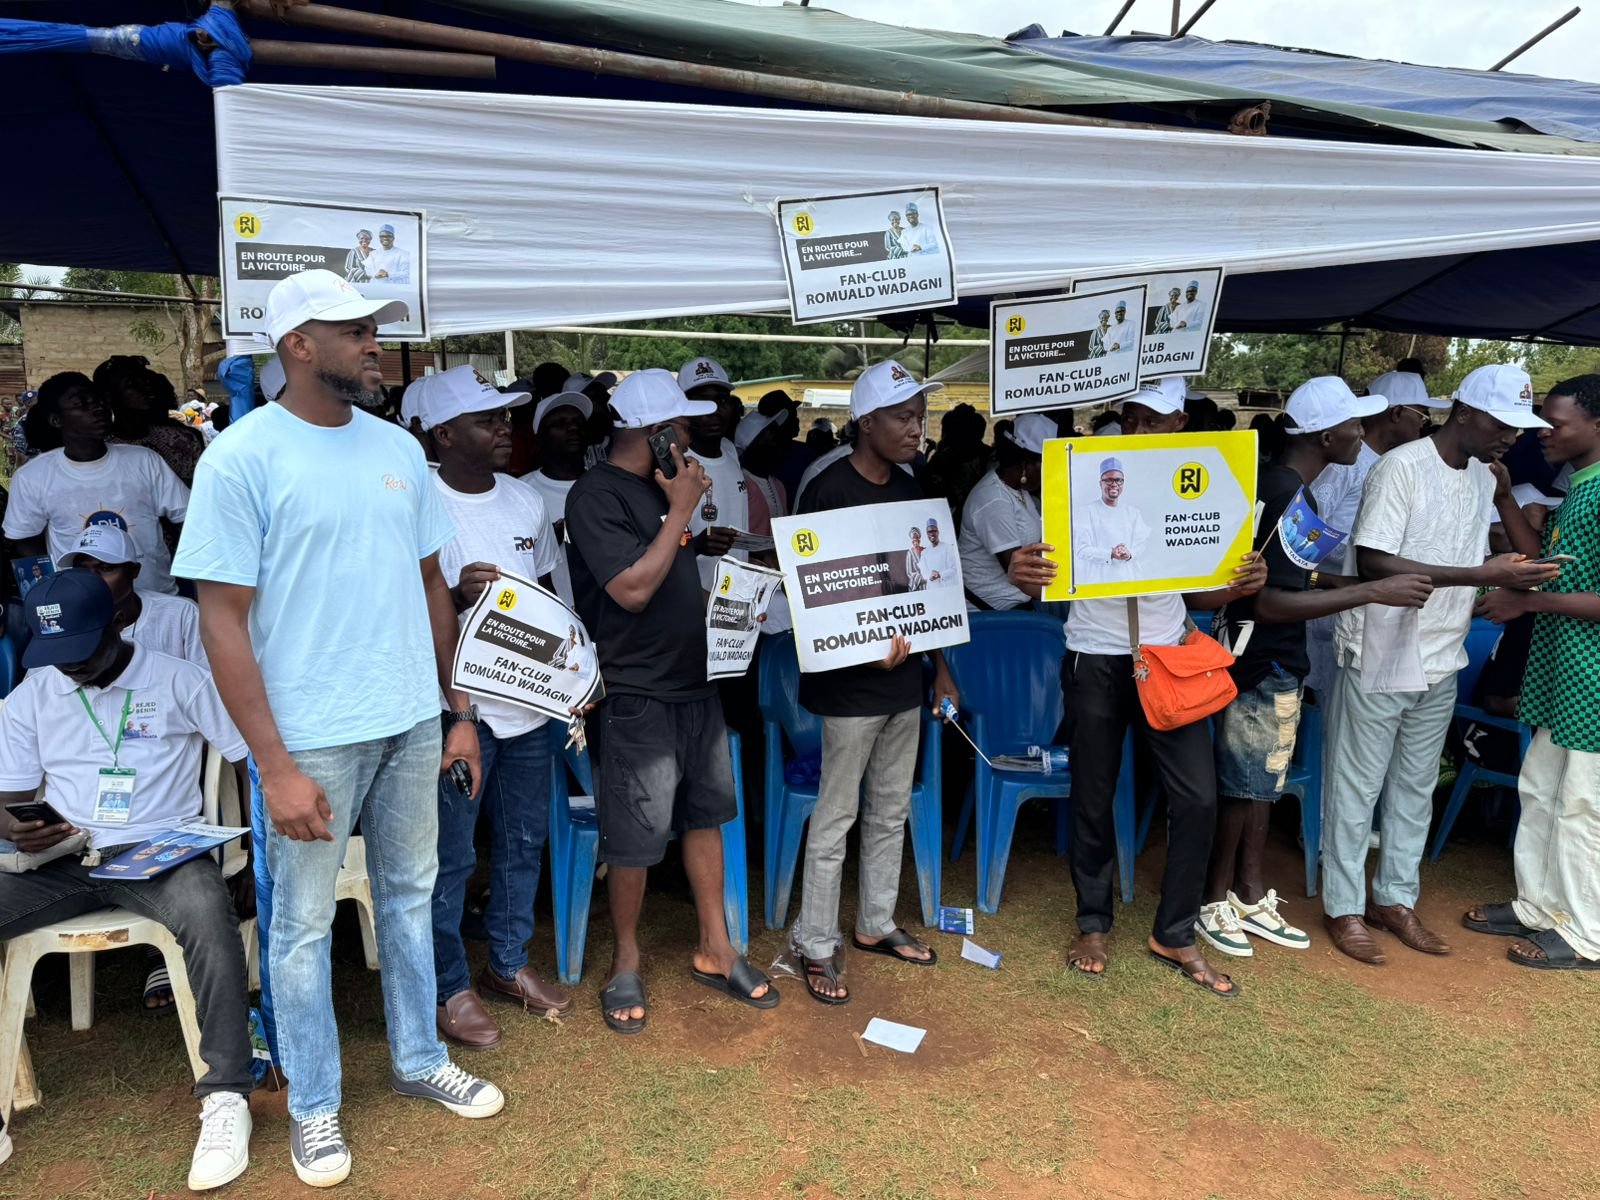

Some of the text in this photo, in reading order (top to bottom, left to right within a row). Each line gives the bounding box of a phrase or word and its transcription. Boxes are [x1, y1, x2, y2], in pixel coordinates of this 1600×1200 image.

[801, 240, 869, 254] EN ROUTE POUR
[803, 249, 862, 262] LA VICTOIRE...
[241, 252, 326, 263] EN ROUTE POUR
[241, 262, 255, 270] LA
[840, 268, 907, 286] FAN-CLUB
[806, 277, 942, 305] ROMUALD WADAGNI
[1009, 340, 1075, 354] EN ROUTE POUR
[1009, 350, 1066, 361] LA VICTOIRE...
[1039, 366, 1102, 383] FAN-CLUB
[1005, 383, 1071, 400] ROMUALD
[1074, 372, 1130, 391] WADAGNI
[1165, 511, 1220, 523] FAN-CLUB
[1165, 524, 1220, 535] ROMUALD
[1165, 536, 1220, 547] WADAGNI
[804, 562, 890, 585] EN ROUTE POUR
[806, 576, 883, 596] LA VICTOIRE...
[855, 602, 927, 626] FAN-CLUB
[481, 625, 533, 651] LA VICTOIRE...
[486, 618, 546, 647] EN ROUTE POUR
[812, 613, 964, 653] ROMUALD WADAGNI
[715, 638, 745, 649] FAN-CLUB
[494, 656, 552, 684] FAN-CLUB
[463, 661, 573, 704] ROMUALD WADAGNI
